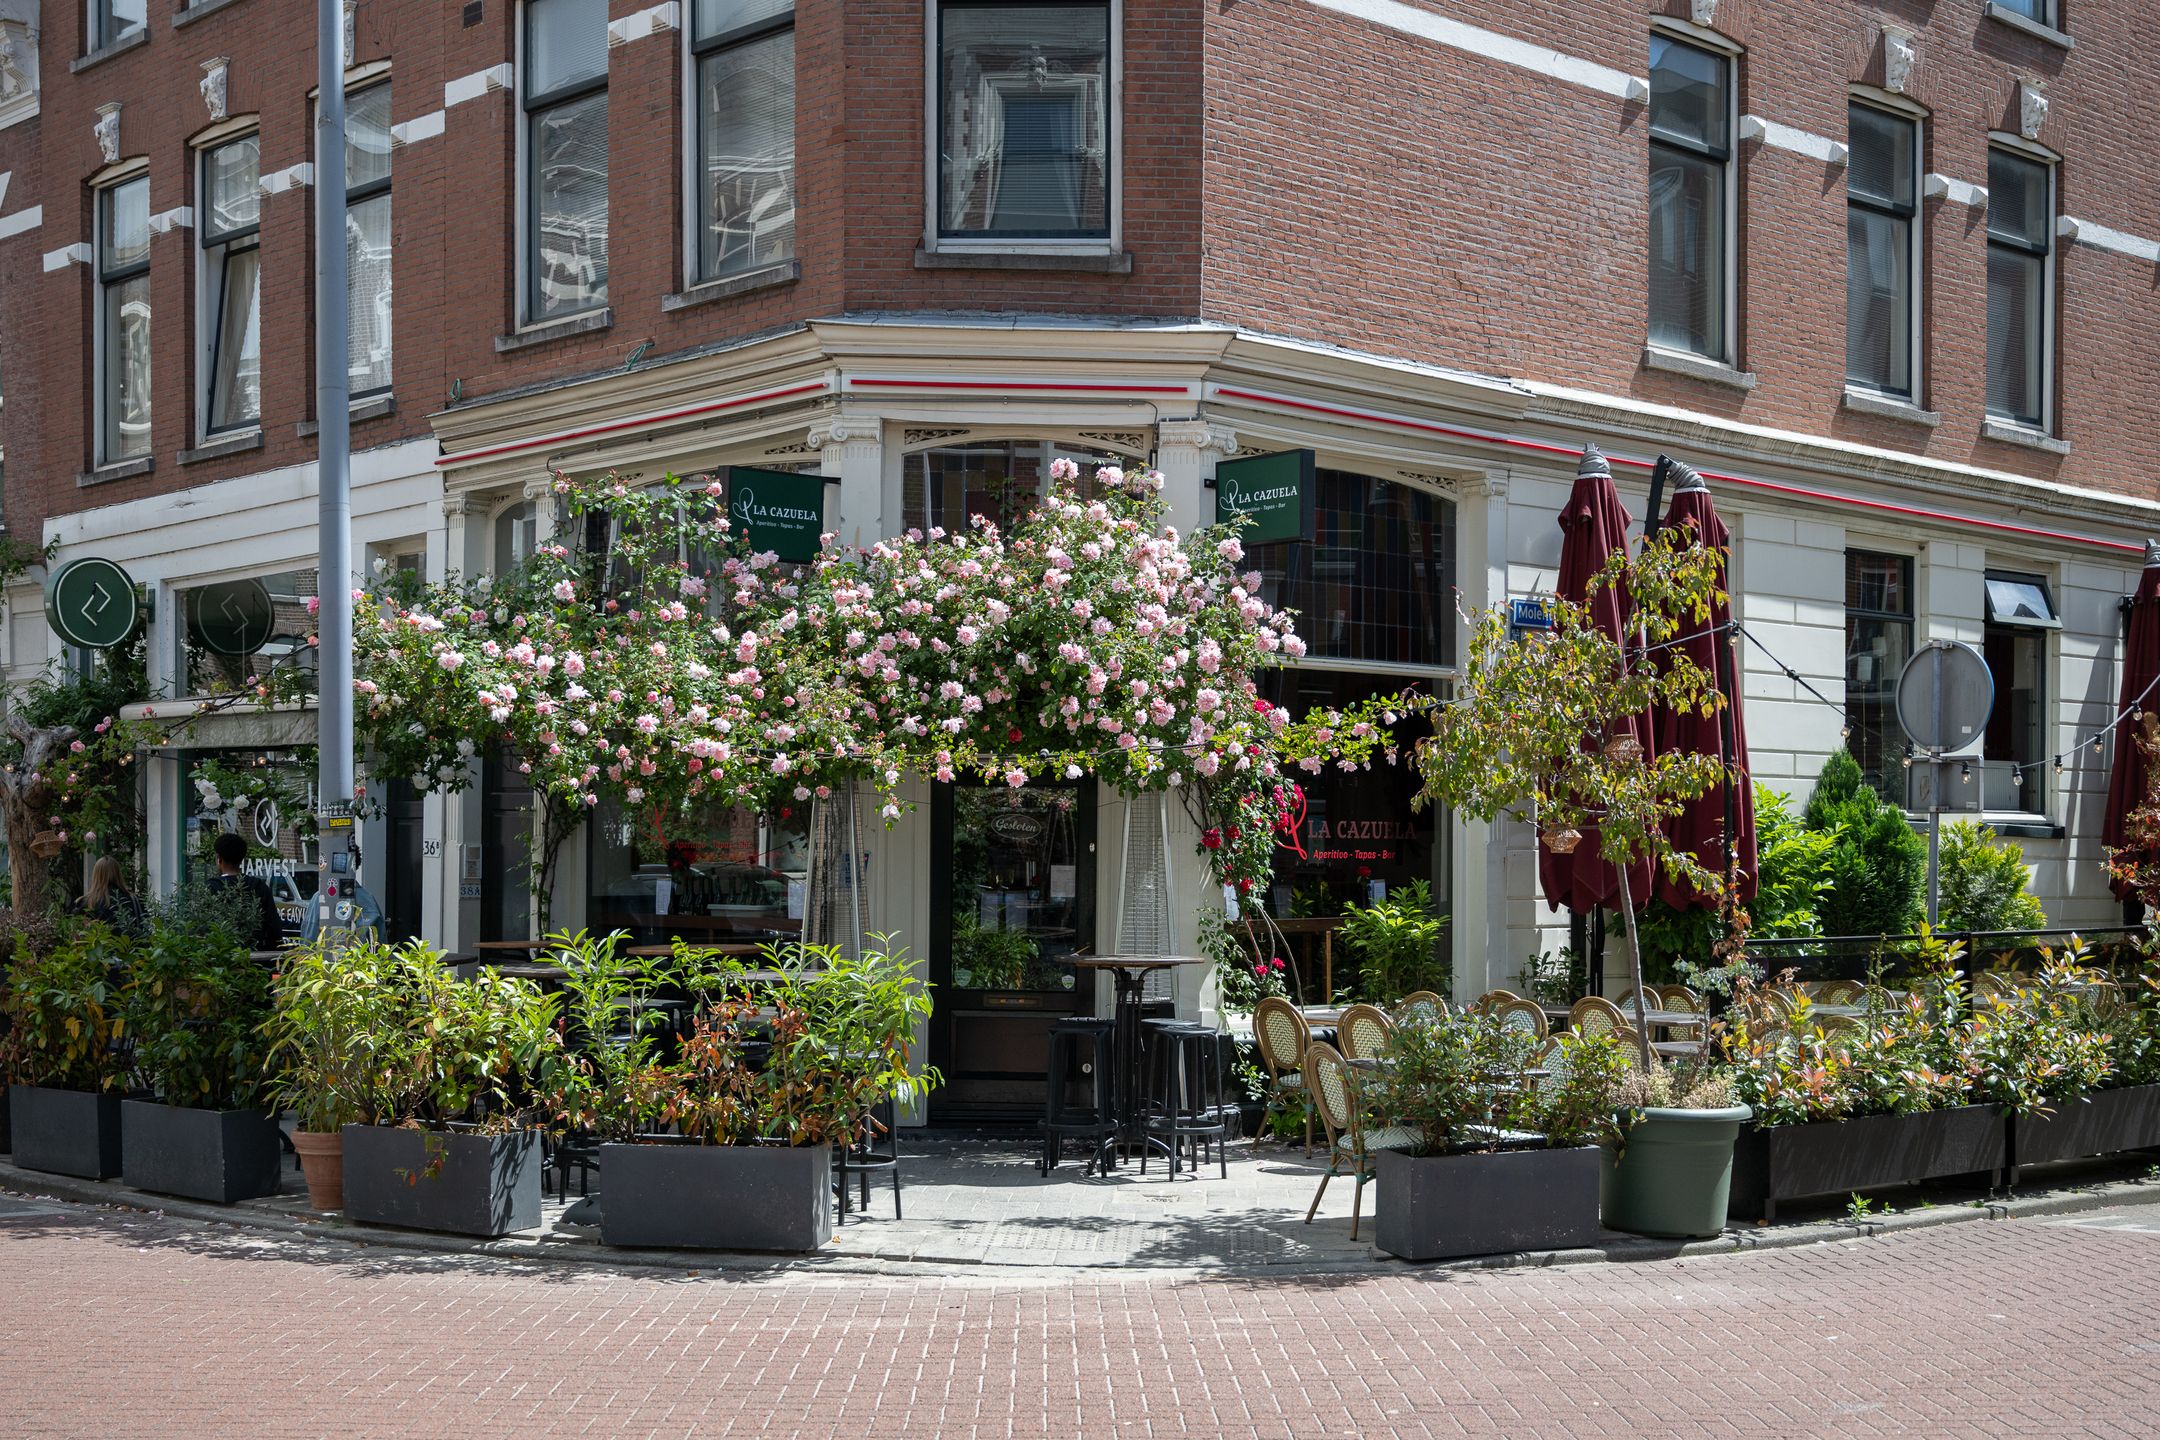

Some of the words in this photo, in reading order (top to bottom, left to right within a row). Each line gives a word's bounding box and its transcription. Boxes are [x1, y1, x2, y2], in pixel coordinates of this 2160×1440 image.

[1239, 492, 1251, 503] LA
[1254, 485, 1298, 501] CAZUELA
[753, 505, 767, 516] LA
[770, 506, 818, 521] CAZUELA
[996, 819, 1036, 832] Gesloten
[1308, 820, 1331, 839] LA
[1336, 820, 1417, 840] CAZUELA
[1355, 849, 1376, 861] Tapas
[1383, 849, 1396, 859] Bar
[460, 886, 480, 896] 38A
